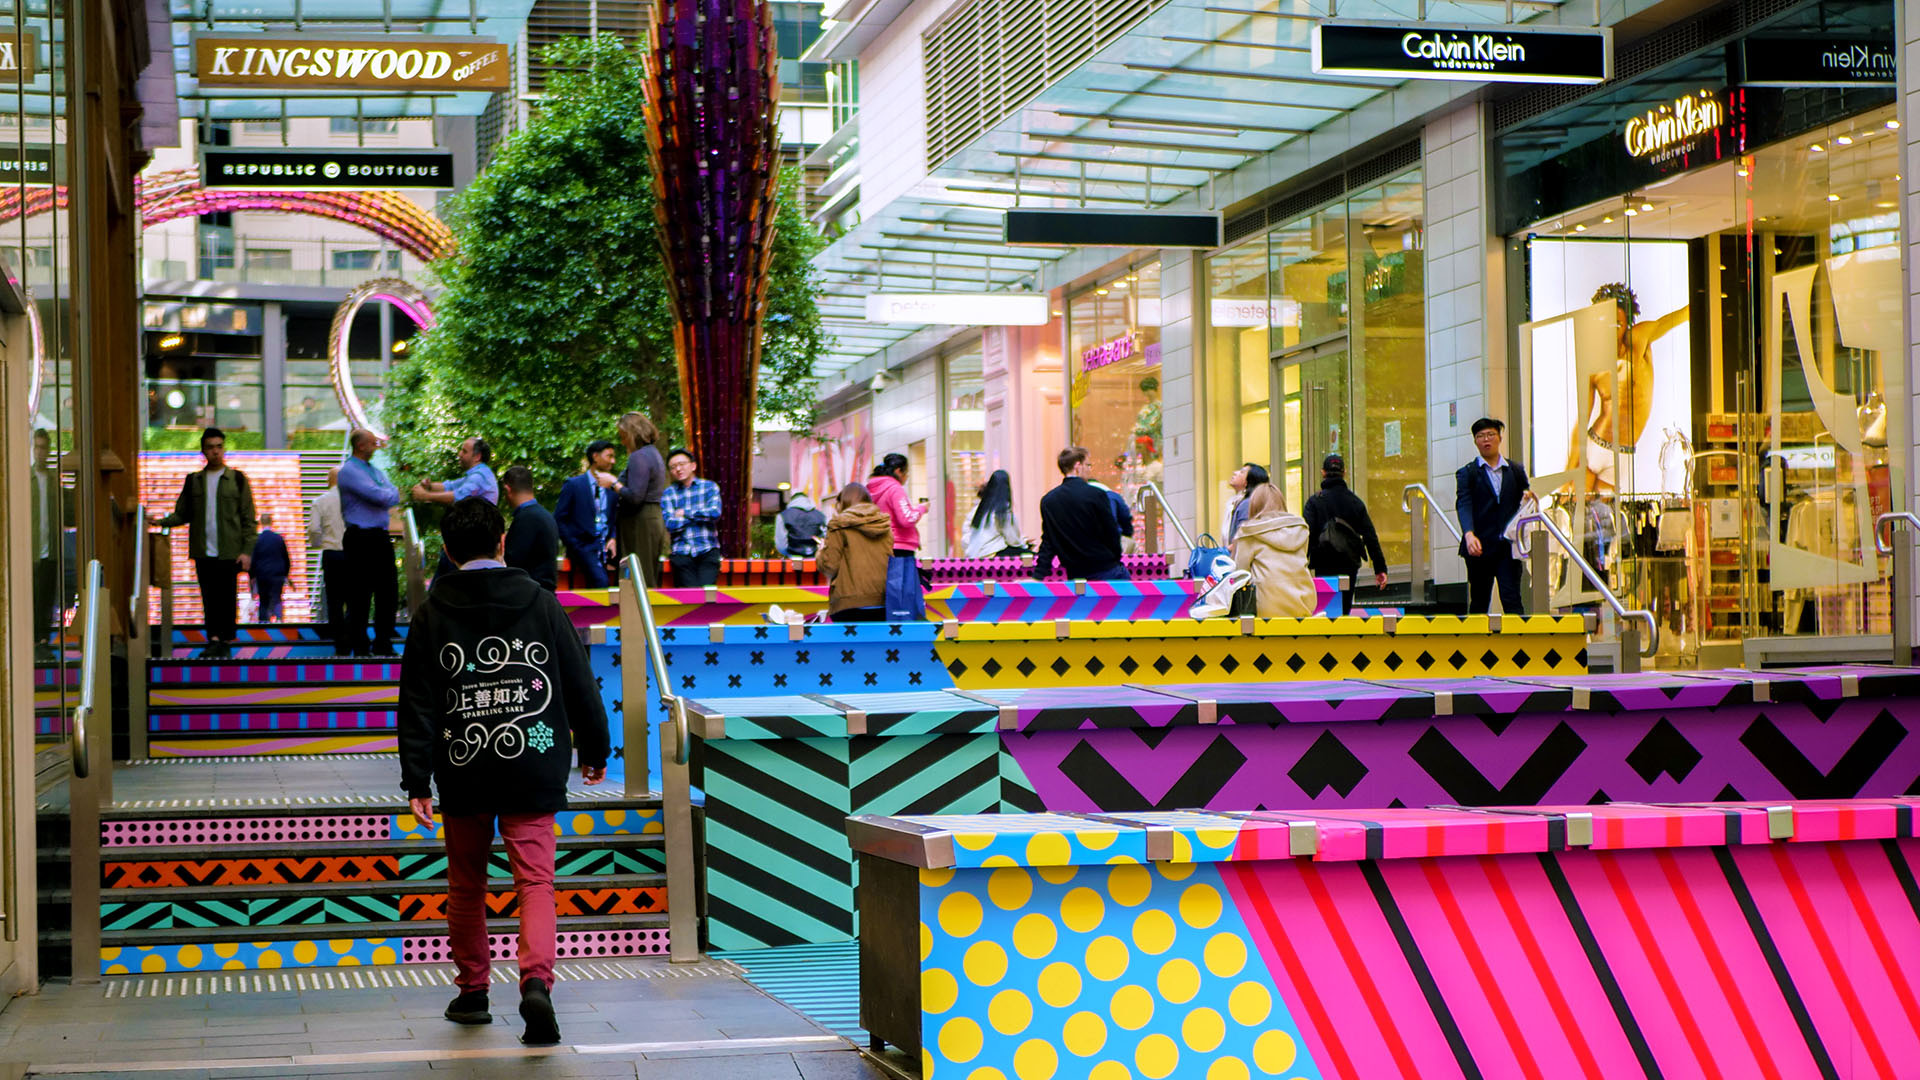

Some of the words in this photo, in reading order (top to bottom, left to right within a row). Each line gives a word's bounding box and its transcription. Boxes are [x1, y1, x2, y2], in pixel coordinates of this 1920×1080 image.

[1401, 32, 1470, 59] Calvin
[1473, 34, 1525, 61] Klein
[208, 47, 452, 80] KINGSWOOD
[453, 50, 499, 81] COFFEE
[1433, 59, 1495, 70] underwear
[1625, 104, 1677, 157] Calvin
[1675, 89, 1723, 140] Klein
[1650, 142, 1696, 165] underwear
[223, 164, 317, 176] REPUBLIC
[347, 165, 440, 177] BOUTIQUE
[456, 686, 530, 711] 上善如水
[462, 706, 503, 719] SPARKLING
[505, 705, 524, 713] SAKE
